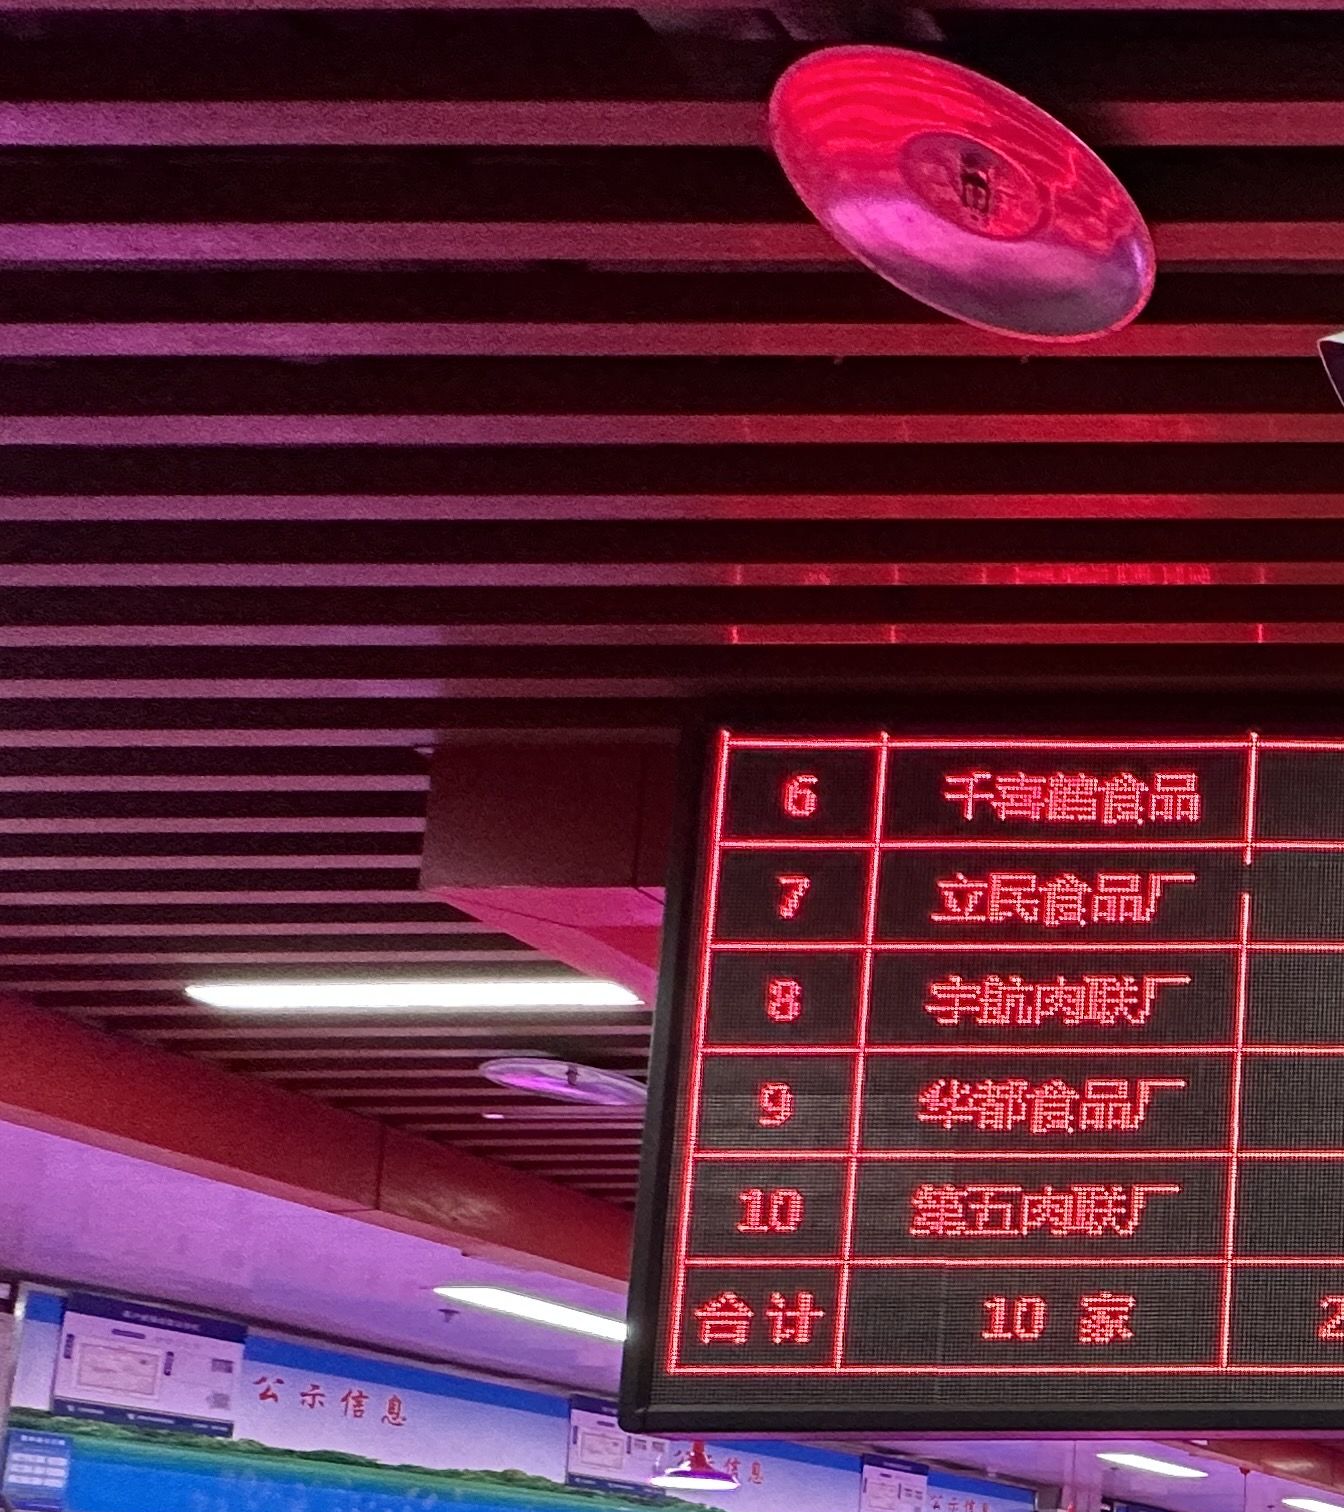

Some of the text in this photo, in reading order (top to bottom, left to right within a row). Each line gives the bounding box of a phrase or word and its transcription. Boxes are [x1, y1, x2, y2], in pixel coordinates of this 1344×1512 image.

[780, 772, 819, 819] 6
[777, 872, 811, 920] 7
[934, 869, 1196, 929] 立民食品厂
[765, 976, 802, 1024] 8
[925, 972, 1191, 1028] 宇航肉联厂
[756, 1080, 795, 1128] 9
[918, 1076, 1186, 1135] 华都食品厂
[736, 1187, 804, 1235] 10
[908, 1182, 1181, 1239] 第五肉联厂
[982, 1291, 1132, 1345] 10 家
[252, 1376, 407, 1426] 公示信息
